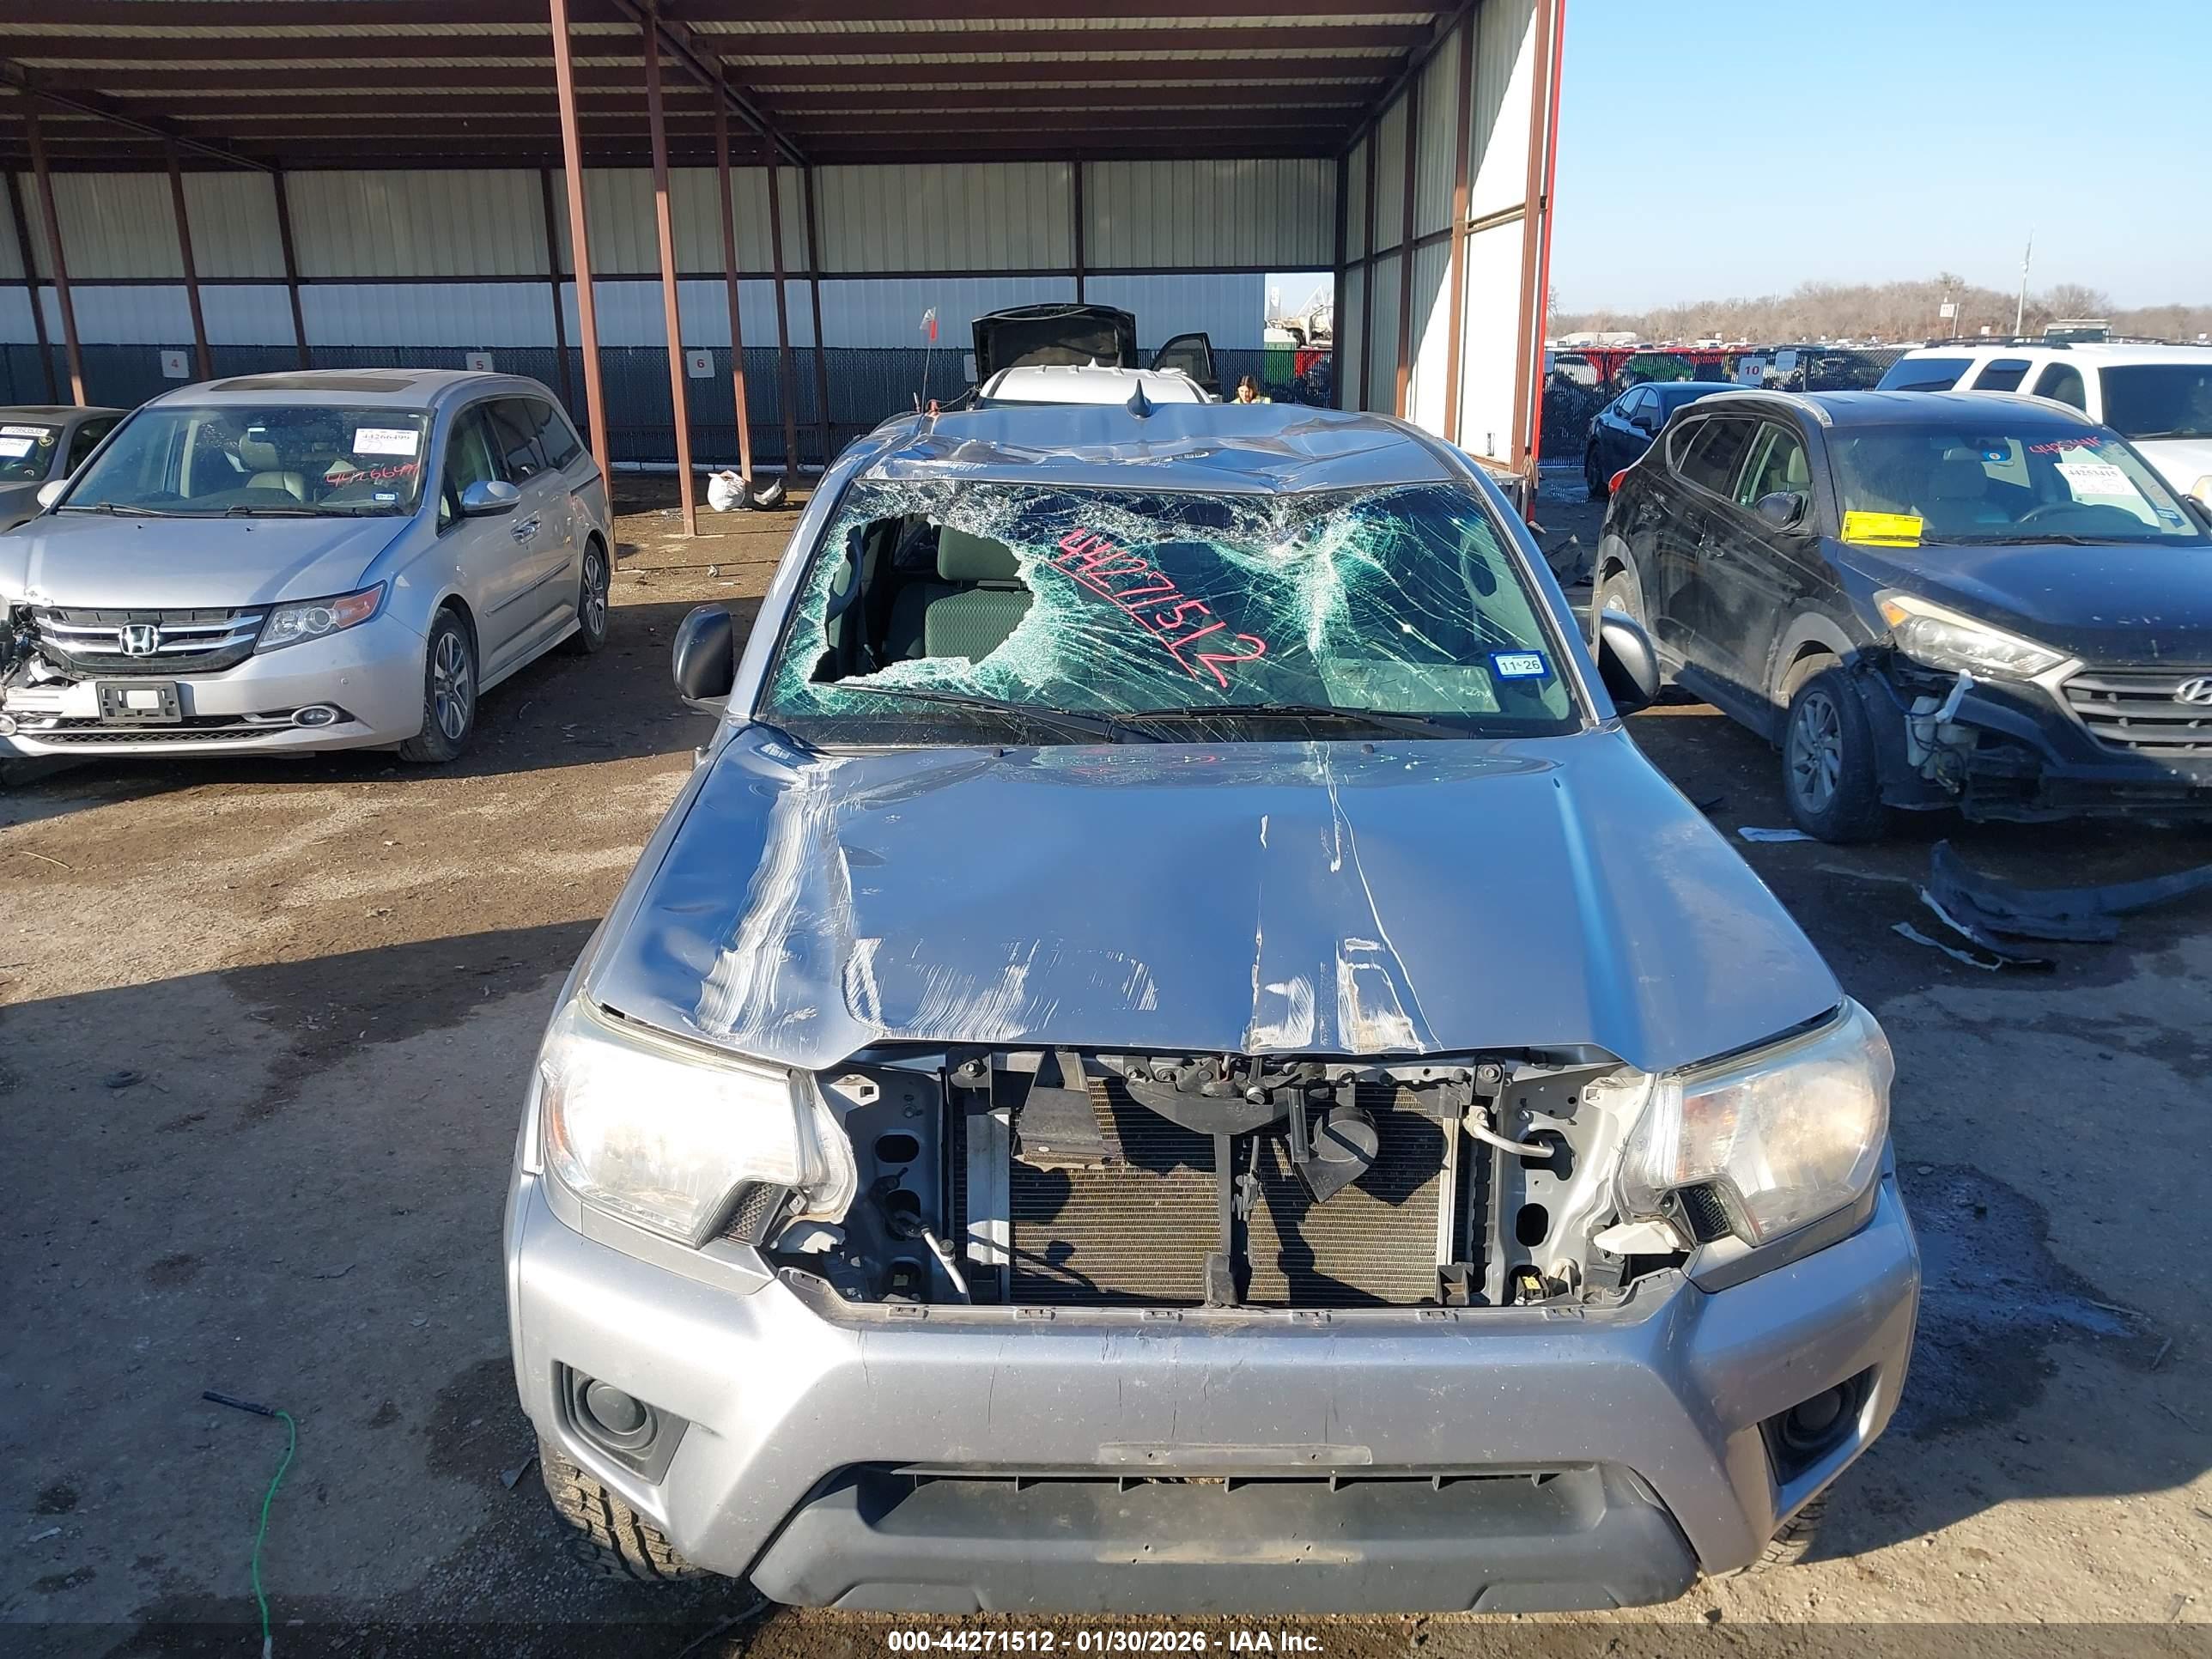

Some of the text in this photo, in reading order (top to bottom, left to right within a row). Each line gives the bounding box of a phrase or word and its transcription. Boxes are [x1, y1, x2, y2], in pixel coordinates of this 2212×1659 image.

[476, 360, 484, 370] 5
[696, 358, 705, 368] 6
[1745, 365, 1760, 375] 10
[1056, 527, 1267, 689] 44271512
